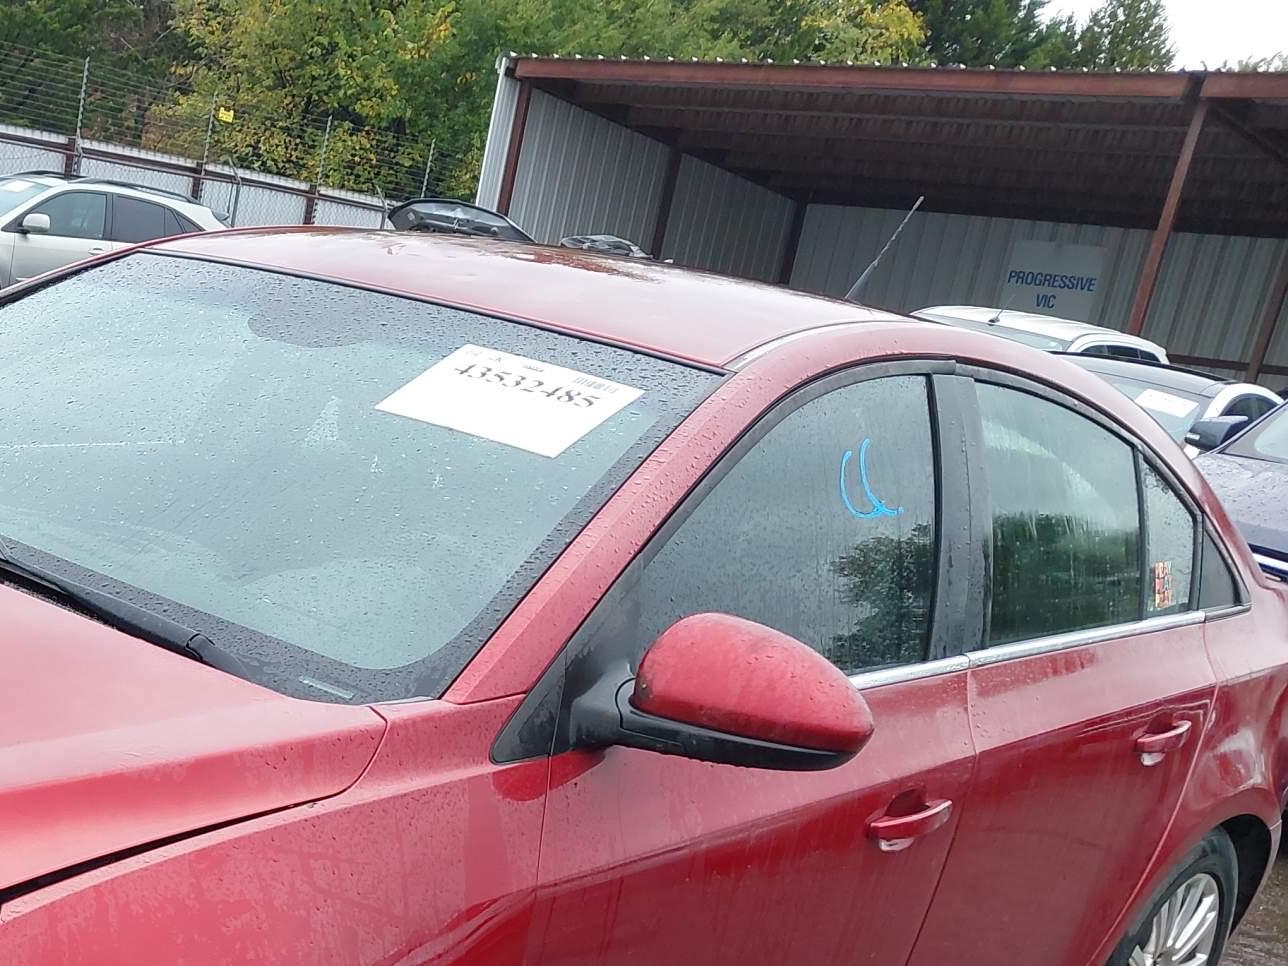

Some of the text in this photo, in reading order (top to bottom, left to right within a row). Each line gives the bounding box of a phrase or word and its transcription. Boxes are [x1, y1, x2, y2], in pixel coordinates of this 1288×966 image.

[1007, 270, 1097, 292] PROGRESSIVE
[1035, 293, 1057, 309] VIC
[454, 363, 601, 408] 43532485
